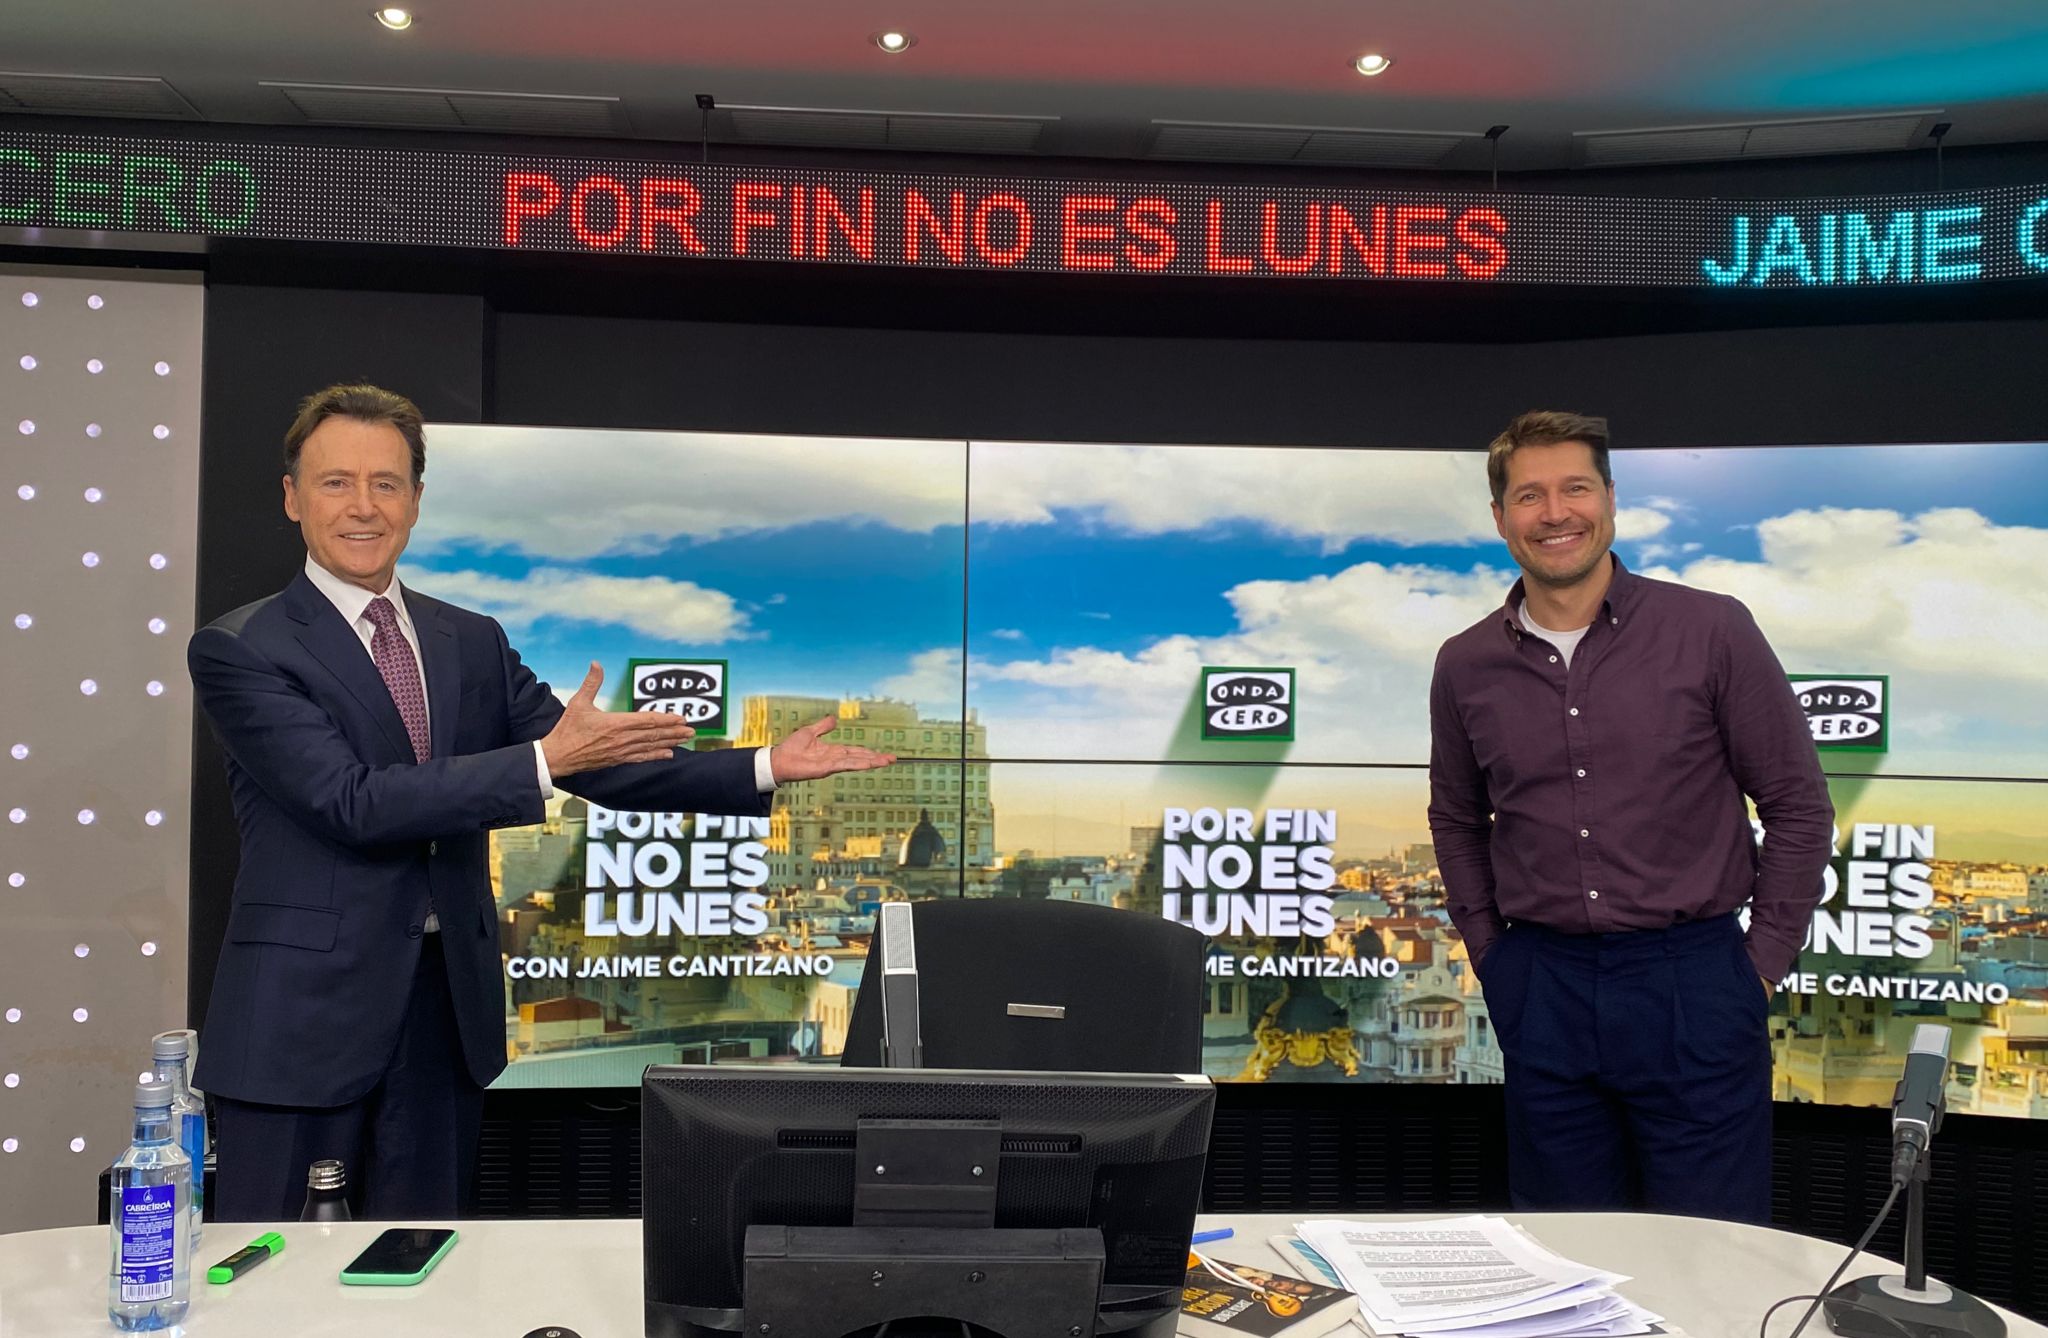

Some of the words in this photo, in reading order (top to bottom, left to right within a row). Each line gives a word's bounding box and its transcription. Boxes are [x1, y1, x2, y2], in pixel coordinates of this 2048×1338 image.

[0, 149, 256, 230] CERO
[505, 172, 704, 253] POR
[732, 181, 873, 259] FIN
[903, 191, 1031, 266] NO
[1062, 195, 1176, 271] ES
[1206, 202, 1507, 279] LUNES
[1703, 206, 1984, 288] JAIME
[645, 677, 710, 691] ONDA
[1217, 685, 1278, 699] ONDA
[1800, 693, 1869, 707] ONDA
[1220, 709, 1278, 725] CERO
[1808, 719, 1869, 735] ERO
[587, 803, 685, 839] POR
[695, 812, 770, 839] FIN
[1164, 807, 1255, 842] POR
[1264, 808, 1337, 842] FIN
[1852, 823, 1935, 859] FIN
[586, 841, 682, 888] NO
[690, 841, 770, 888] ES
[1163, 844, 1253, 890] NO
[1260, 845, 1337, 890] ES
[1848, 860, 1935, 910] ES
[584, 892, 770, 937] LUNES
[1162, 893, 1336, 937] LUNES
[1738, 902, 1935, 959] NES
[507, 956, 568, 979] CON
[575, 956, 661, 979] JAIME
[667, 955, 835, 978] CANTIZANO
[1241, 956, 1400, 978] CANTIZANO
[1825, 974, 2010, 1005] CANTIZANO
